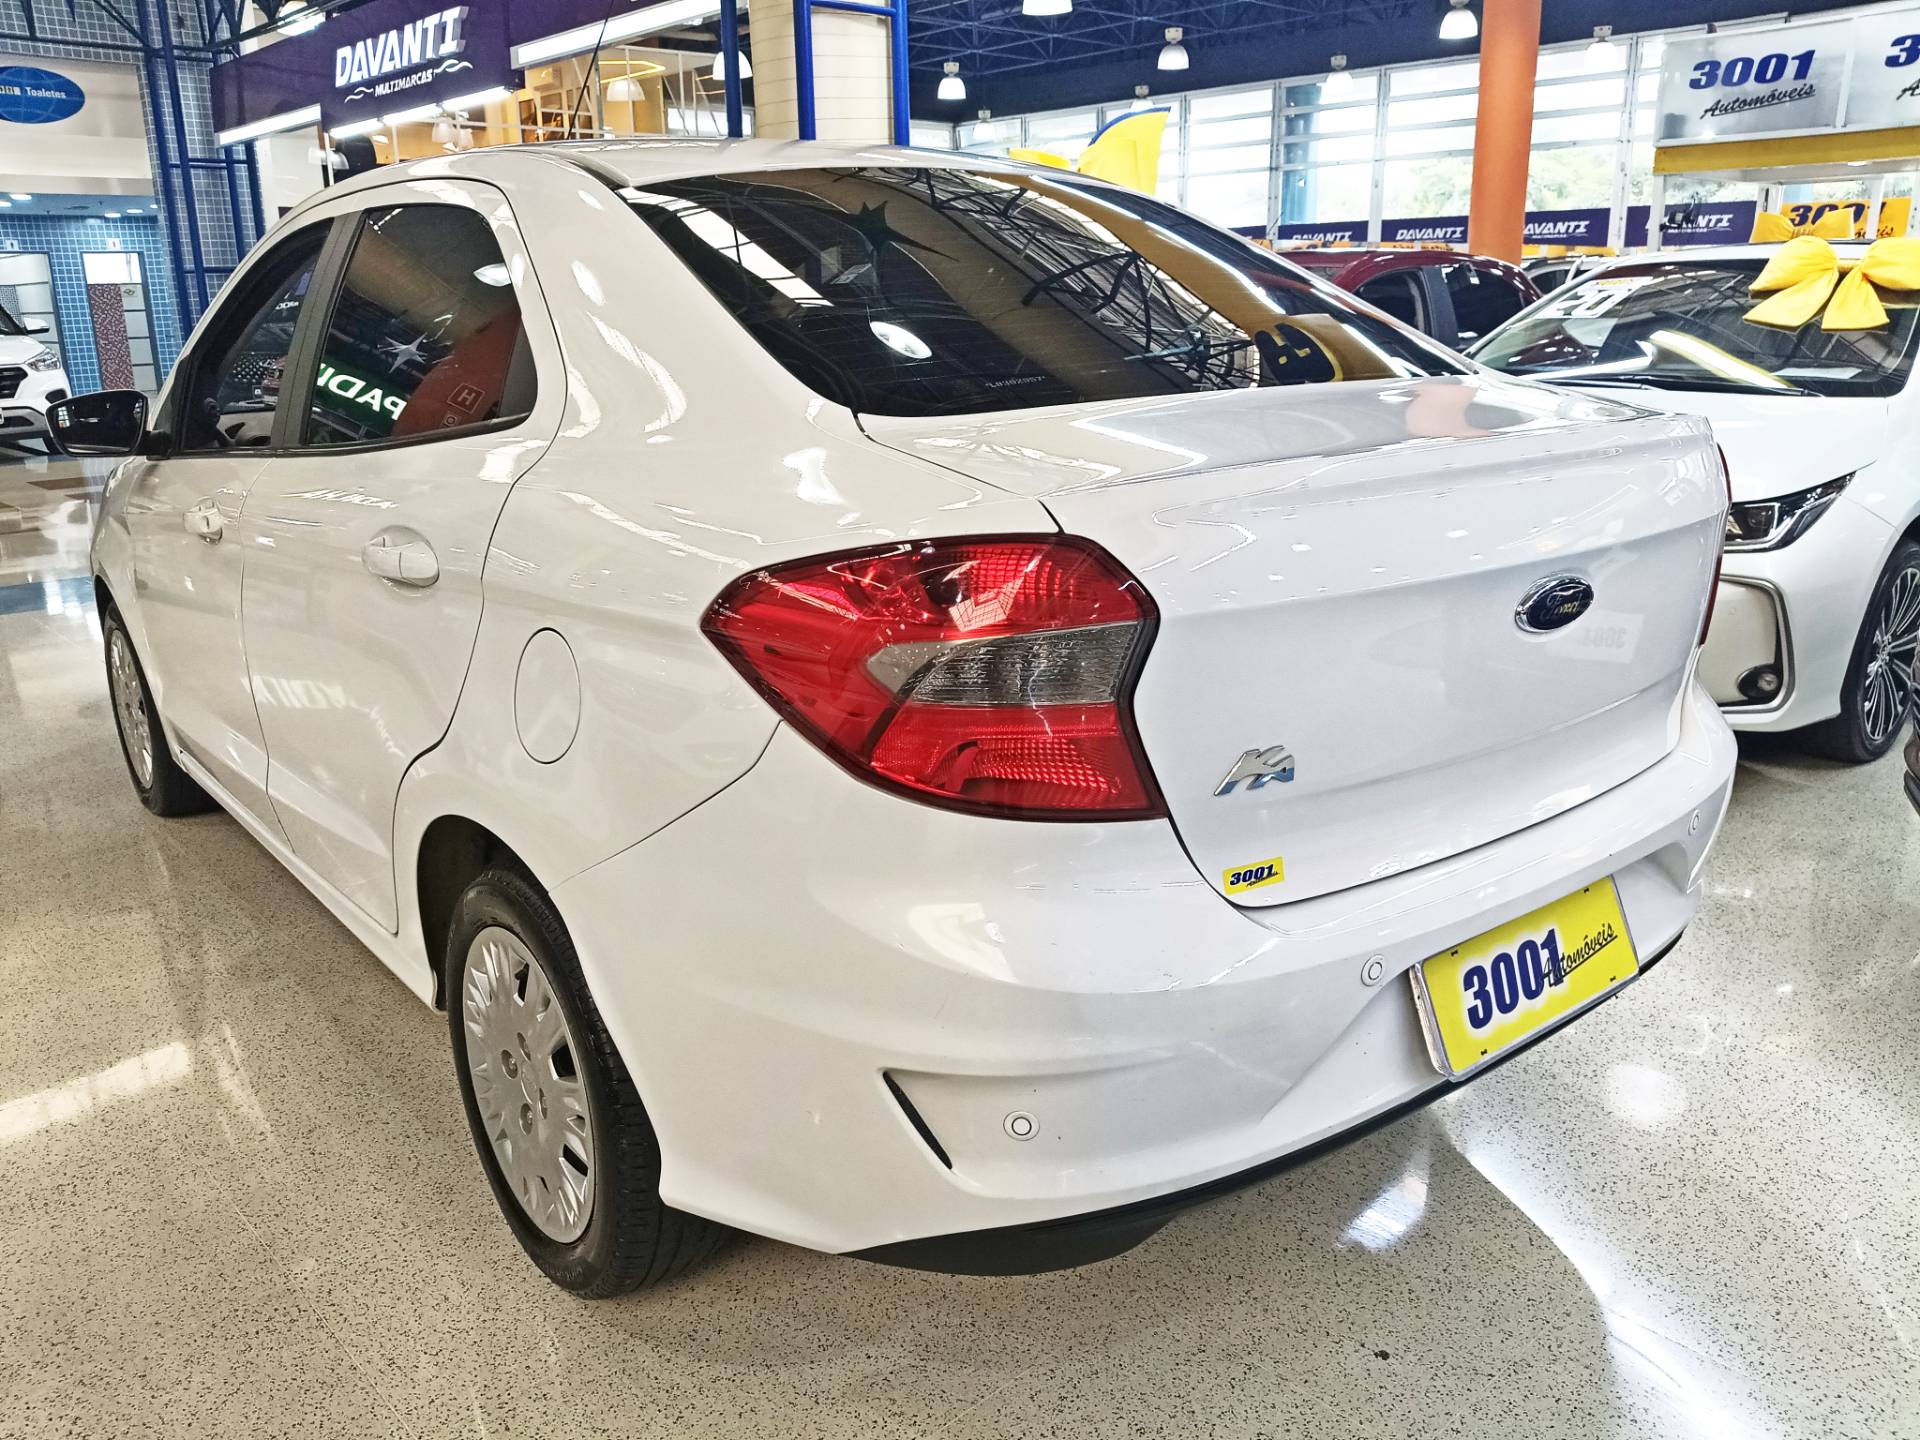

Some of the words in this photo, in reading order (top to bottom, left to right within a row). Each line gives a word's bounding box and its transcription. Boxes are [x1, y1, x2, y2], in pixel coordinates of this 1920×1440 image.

[335, 5, 469, 88] DAVANTI
[374, 68, 433, 97] MULTIMARCAS
[1689, 49, 1816, 90] 3001
[24, 86, 66, 99] Toaletes
[1700, 82, 1817, 119] Automóveis
[1395, 226, 1465, 241] DAVANTI
[1523, 220, 1590, 235] AVANTI
[1229, 863, 1275, 886] 3001
[1463, 928, 1564, 1030] 3001
